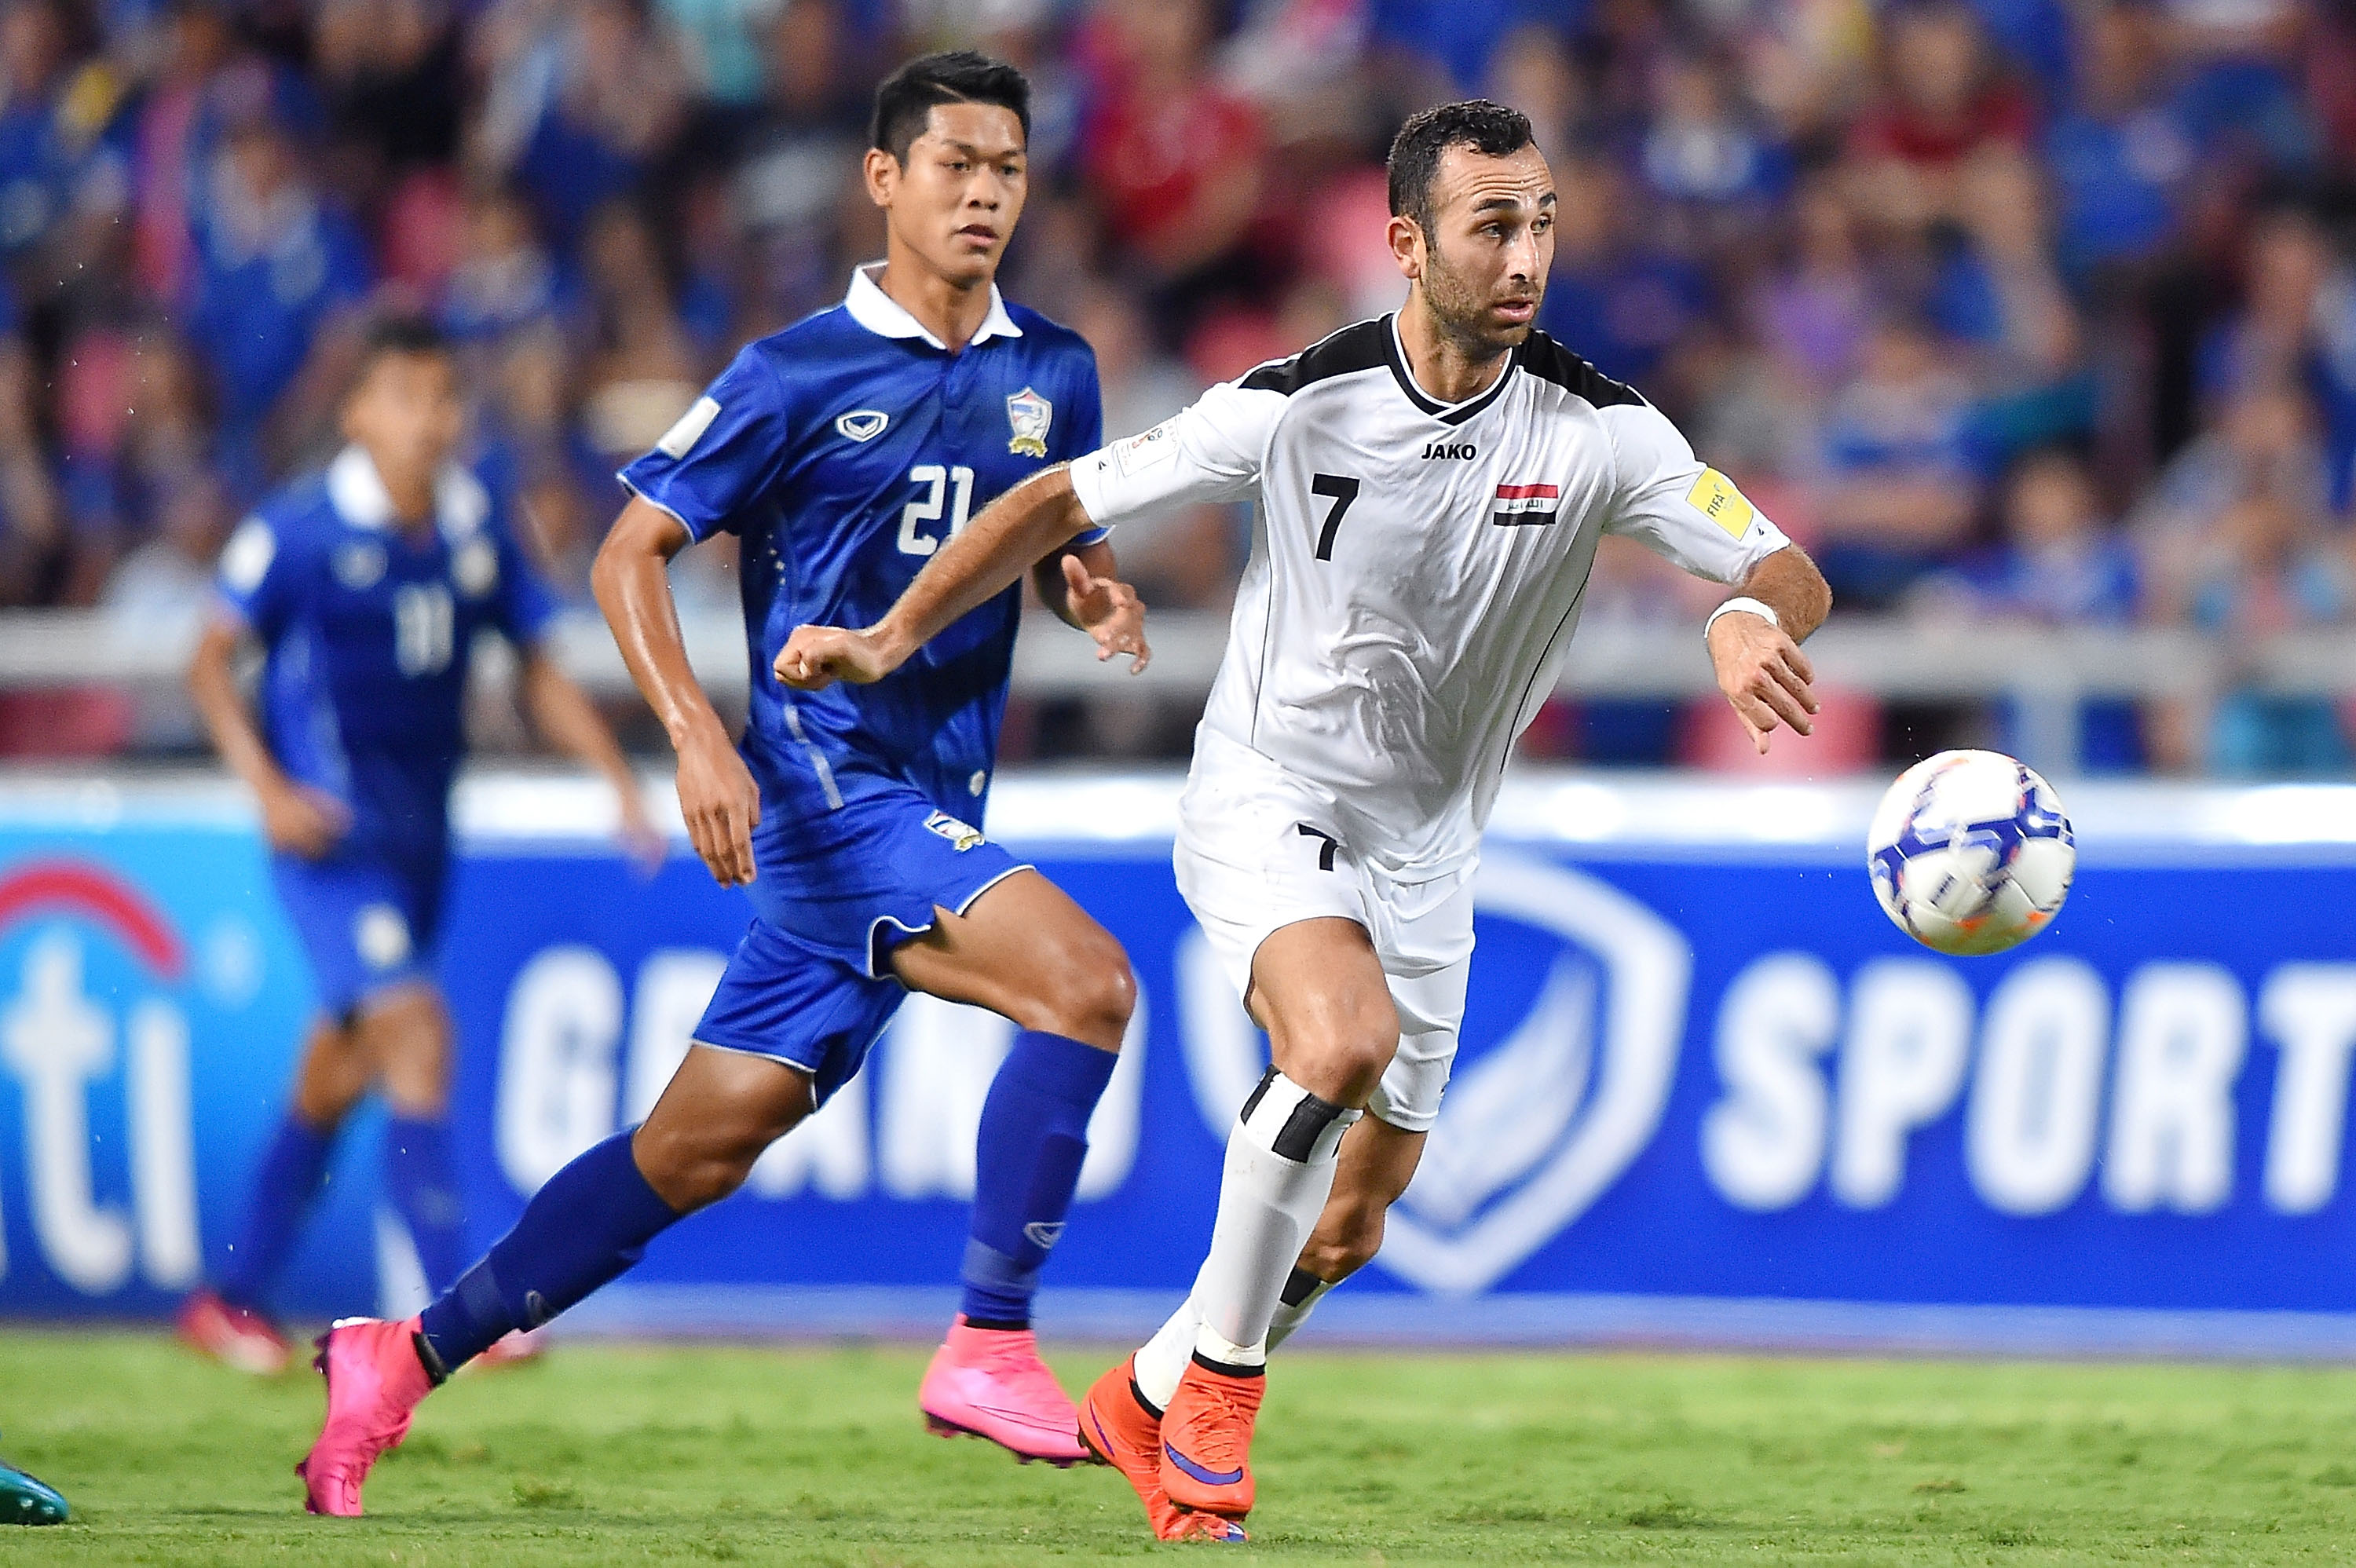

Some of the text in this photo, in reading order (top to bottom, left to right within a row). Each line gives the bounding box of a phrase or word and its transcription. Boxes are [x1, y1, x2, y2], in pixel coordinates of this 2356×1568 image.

[1421, 443, 1477, 461] JAKO
[898, 465, 975, 556] 21
[1311, 473, 1360, 562] 7
[1707, 493, 1726, 517] FIFA
[1297, 823, 1338, 872] 7
[1700, 952, 2356, 1215] SPORT
